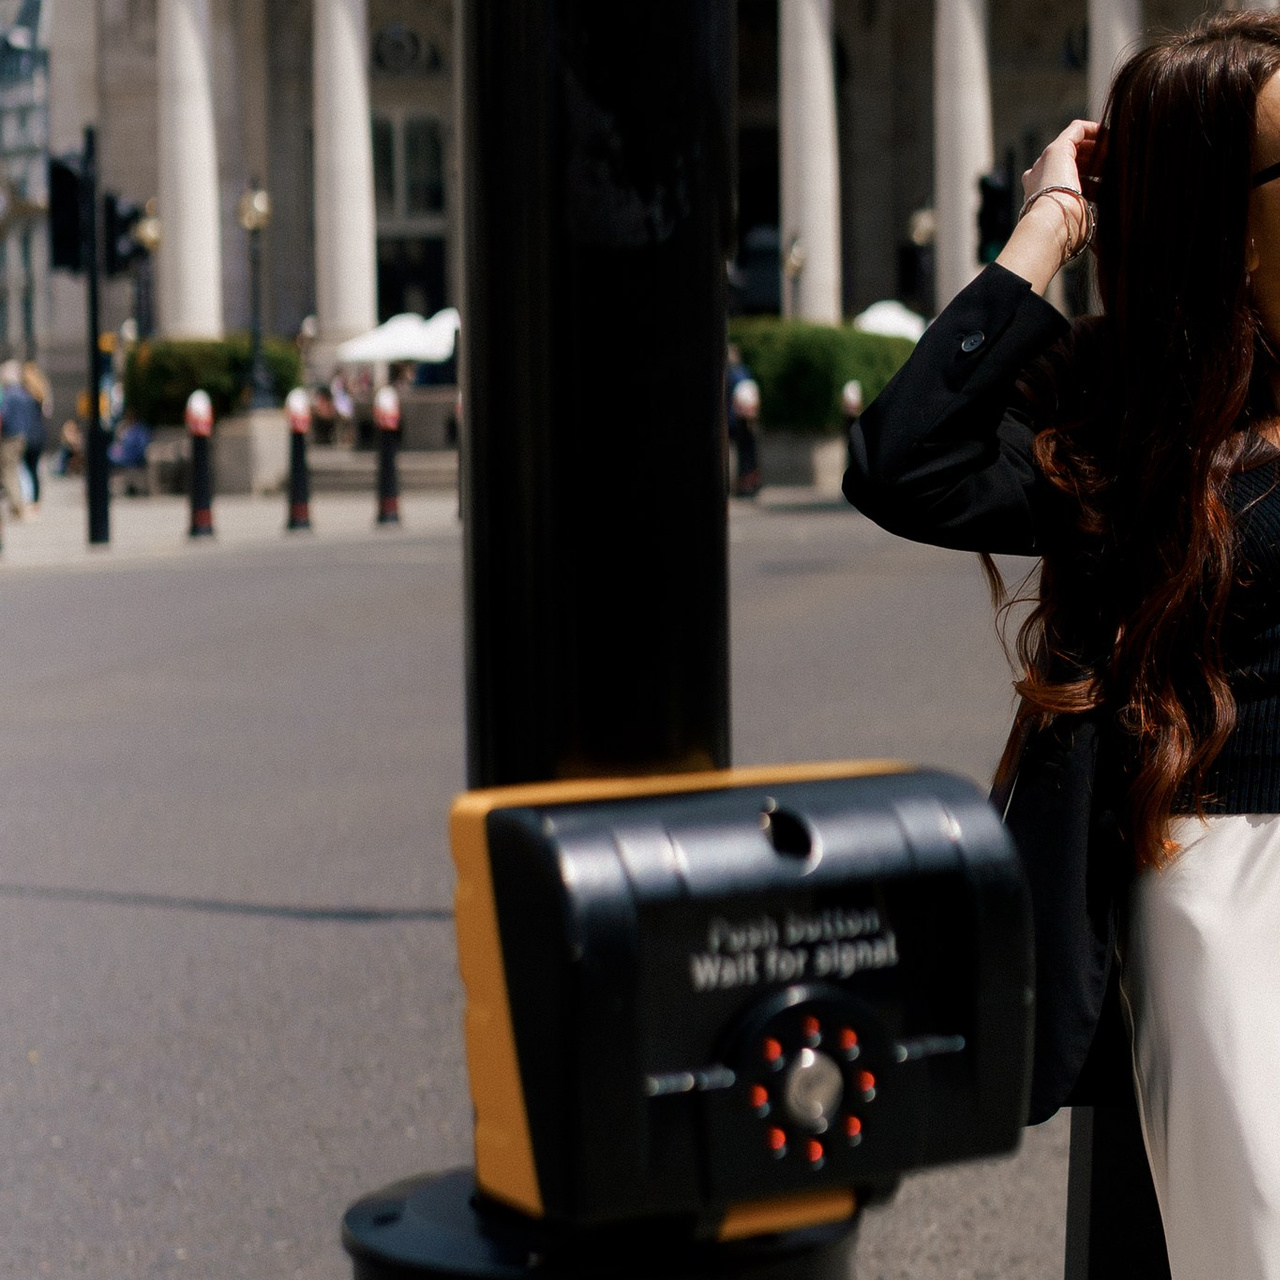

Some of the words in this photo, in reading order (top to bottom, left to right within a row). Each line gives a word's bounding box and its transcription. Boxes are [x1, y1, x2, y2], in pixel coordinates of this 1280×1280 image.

[691, 951, 759, 992] Wait
[765, 945, 808, 982] for
[815, 931, 898, 979] signal
